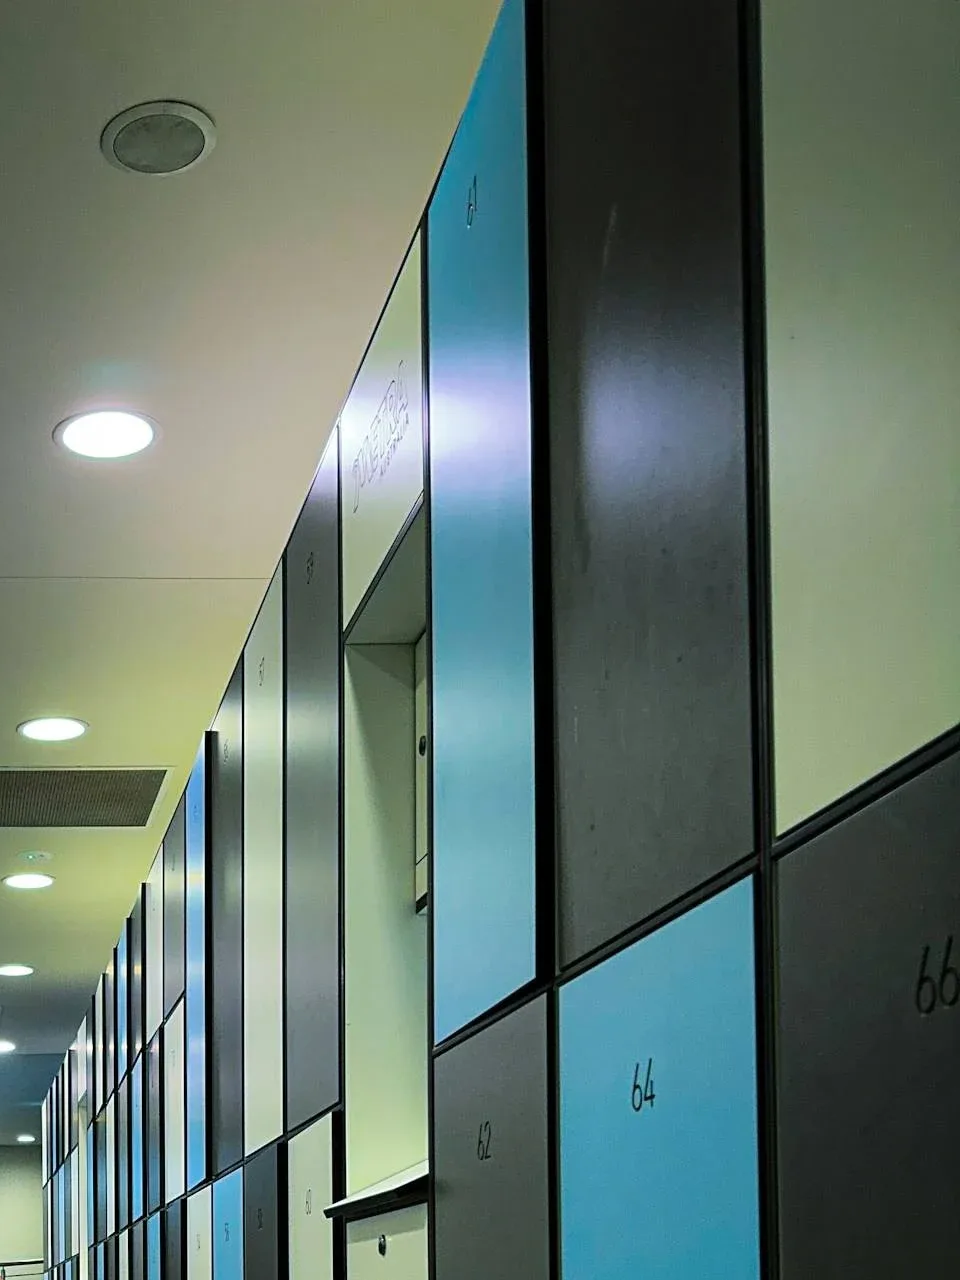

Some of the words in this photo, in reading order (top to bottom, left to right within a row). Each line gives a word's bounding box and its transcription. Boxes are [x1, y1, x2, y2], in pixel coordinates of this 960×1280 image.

[467, 175, 477, 227] 61
[916, 935, 960, 1014] 66
[632, 1058, 655, 1112] 64
[477, 1120, 491, 1160] 62
